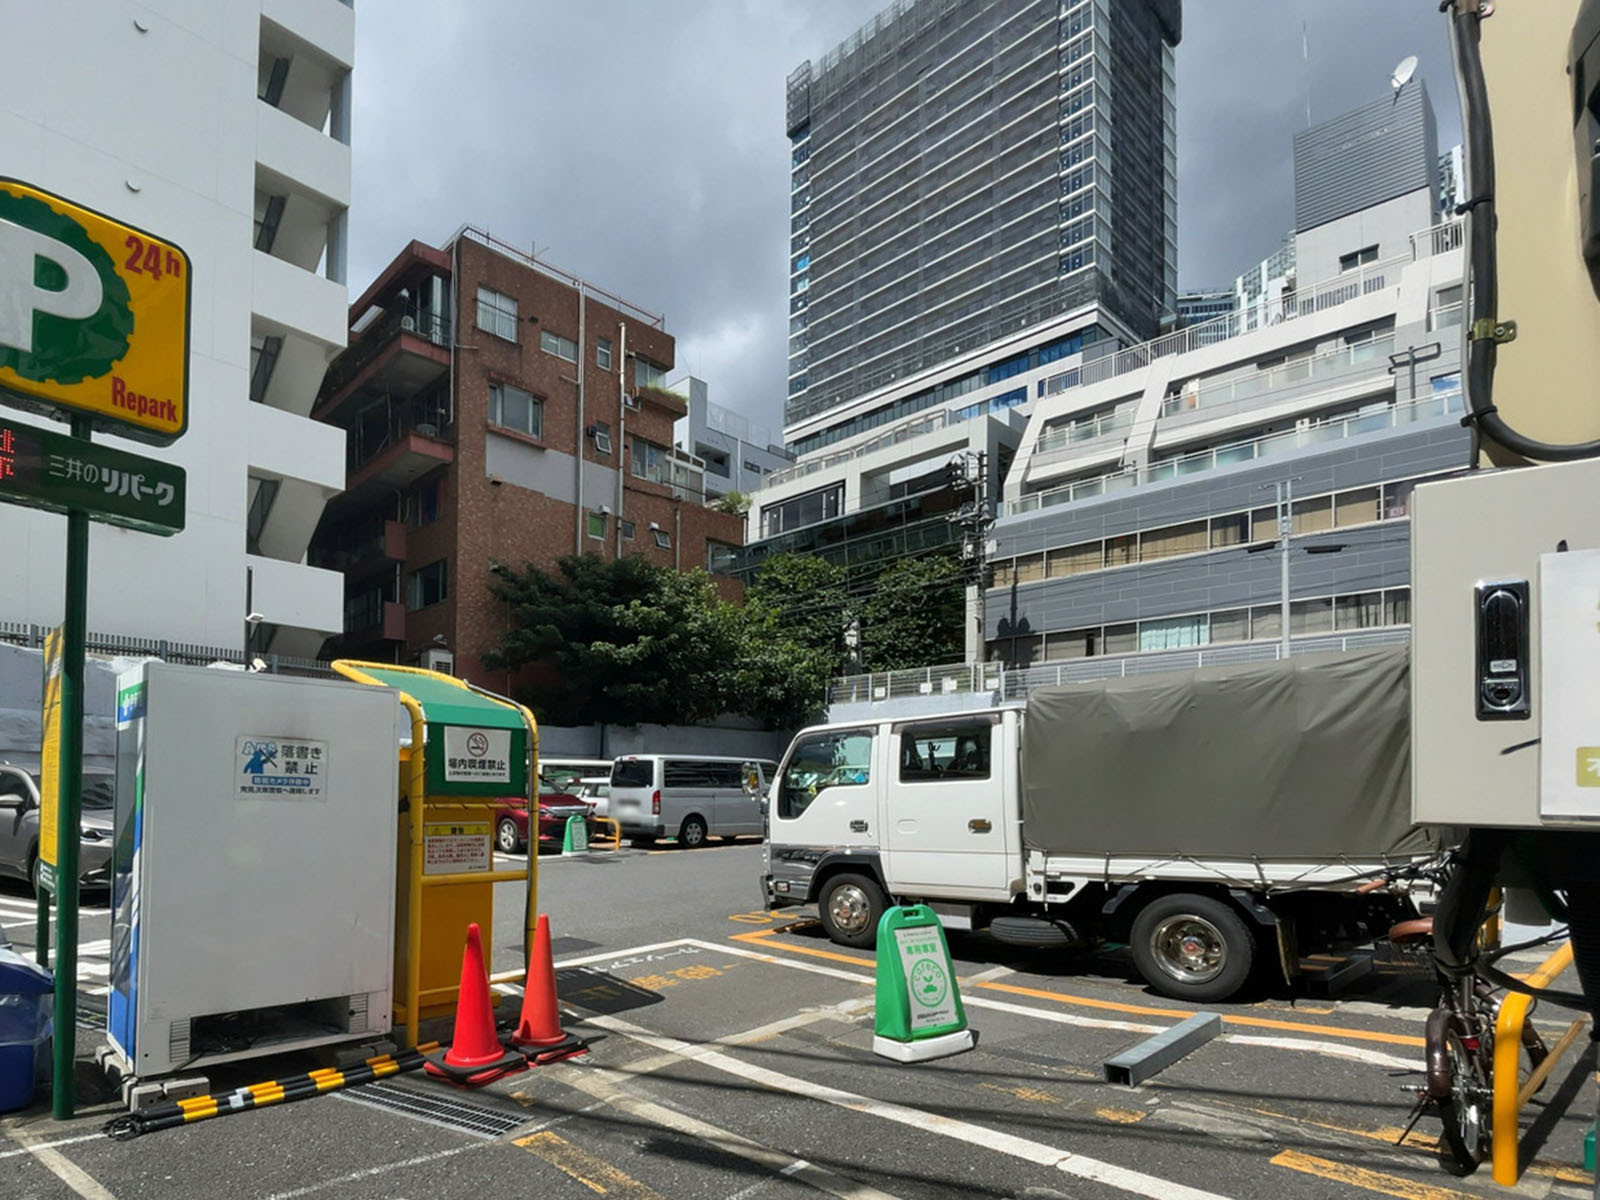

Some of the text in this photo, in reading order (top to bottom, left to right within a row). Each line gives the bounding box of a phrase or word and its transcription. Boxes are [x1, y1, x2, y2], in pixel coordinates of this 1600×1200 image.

[125, 235, 181, 281] 24h
[0, 217, 103, 353] P
[111, 375, 178, 423] Repark
[49, 454, 175, 506] 三井のリパーク
[281, 745, 322, 760] 落書き
